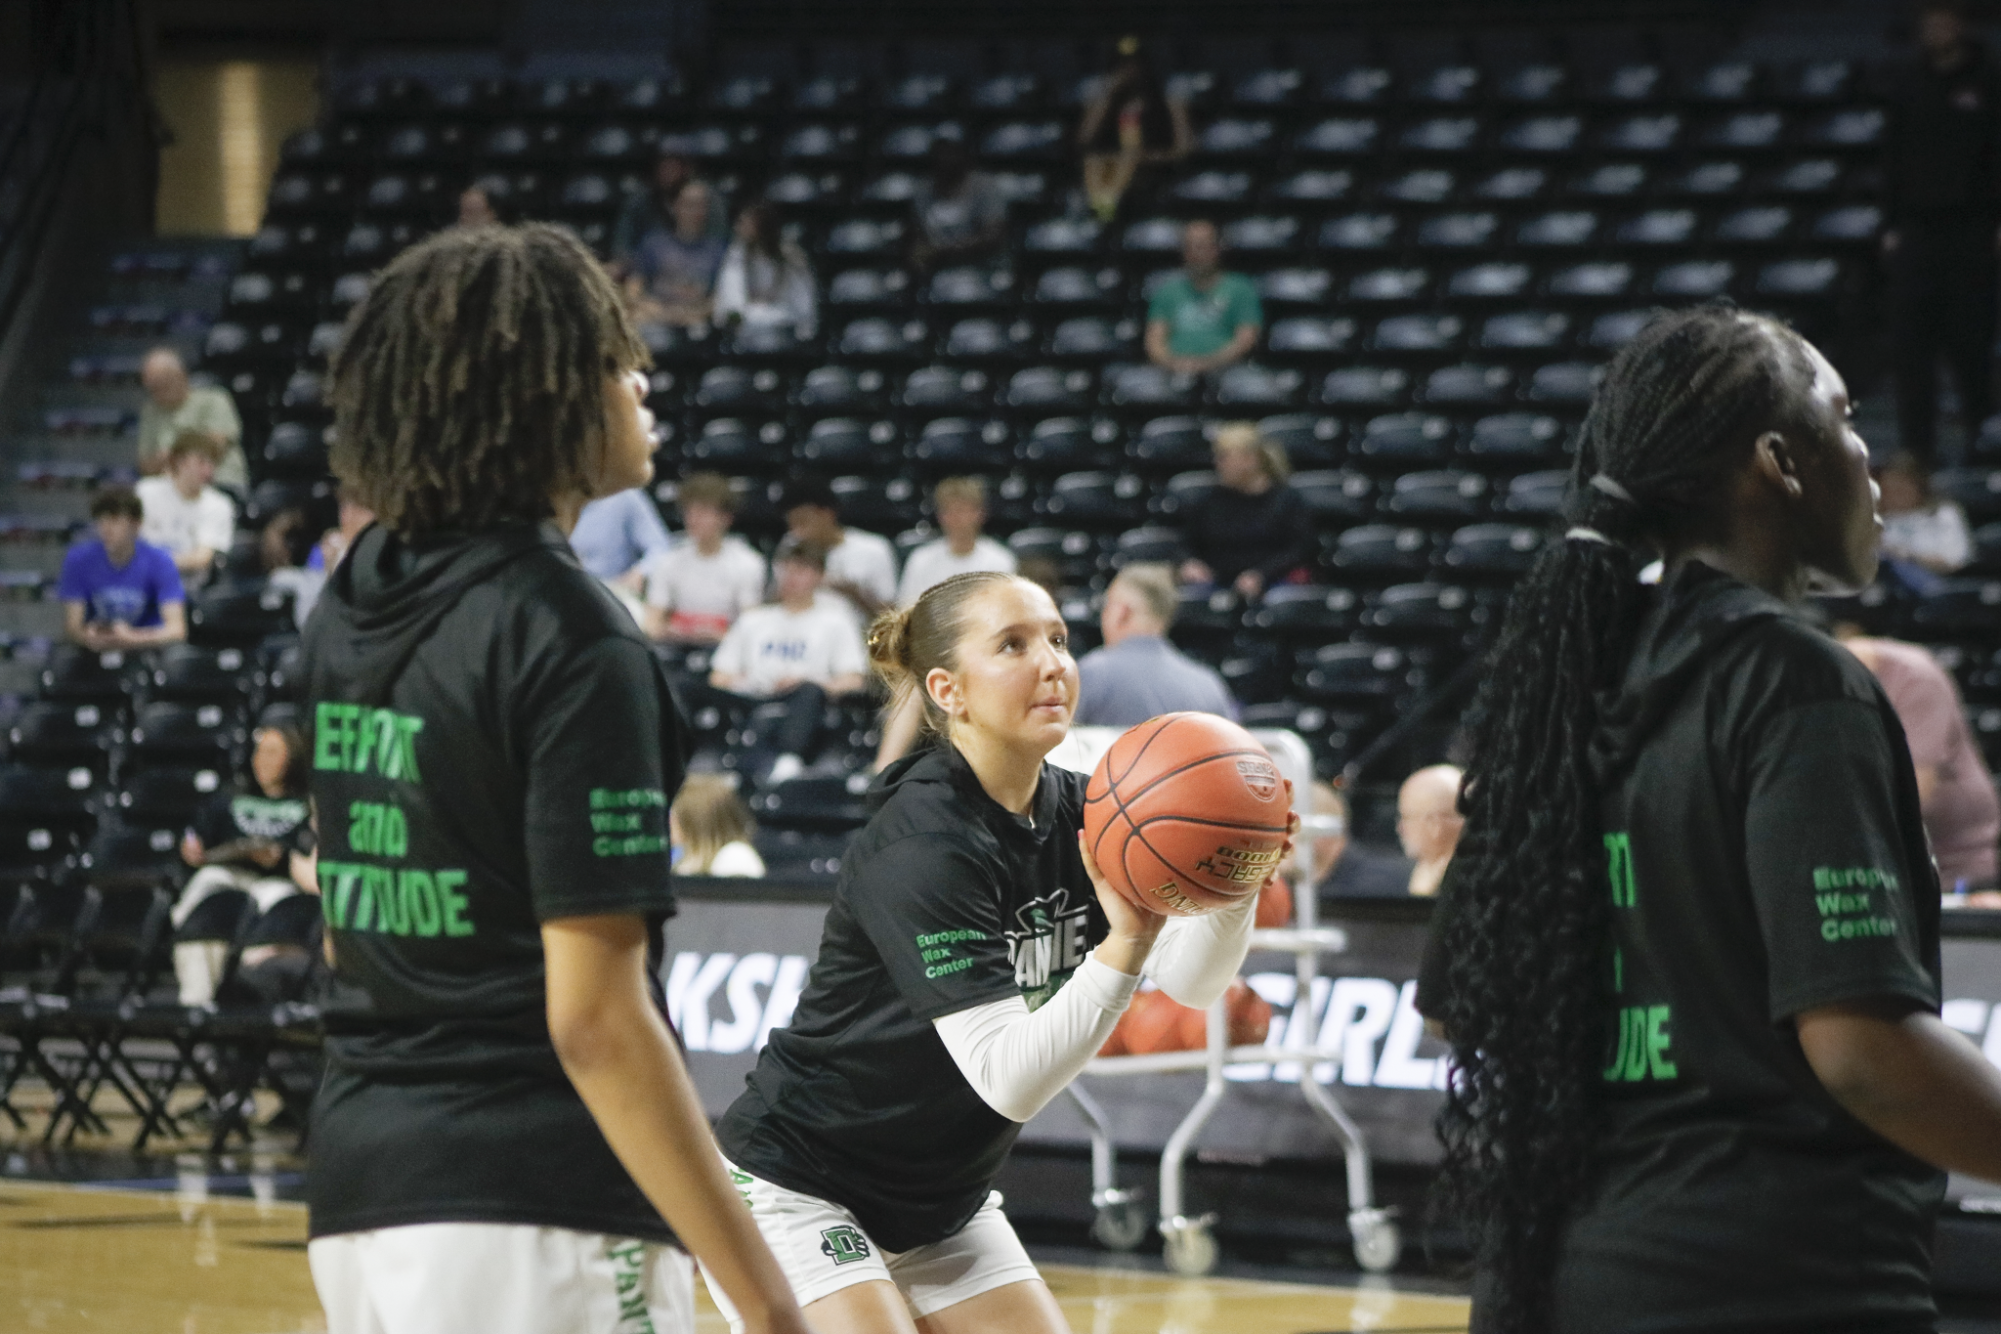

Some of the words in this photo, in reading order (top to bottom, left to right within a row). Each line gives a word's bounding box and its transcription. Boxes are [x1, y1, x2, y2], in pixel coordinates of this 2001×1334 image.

[916, 929, 987, 948] European
[921, 948, 952, 964] Wax
[925, 957, 974, 979] Center
[1222, 972, 1452, 1091] GIRL
